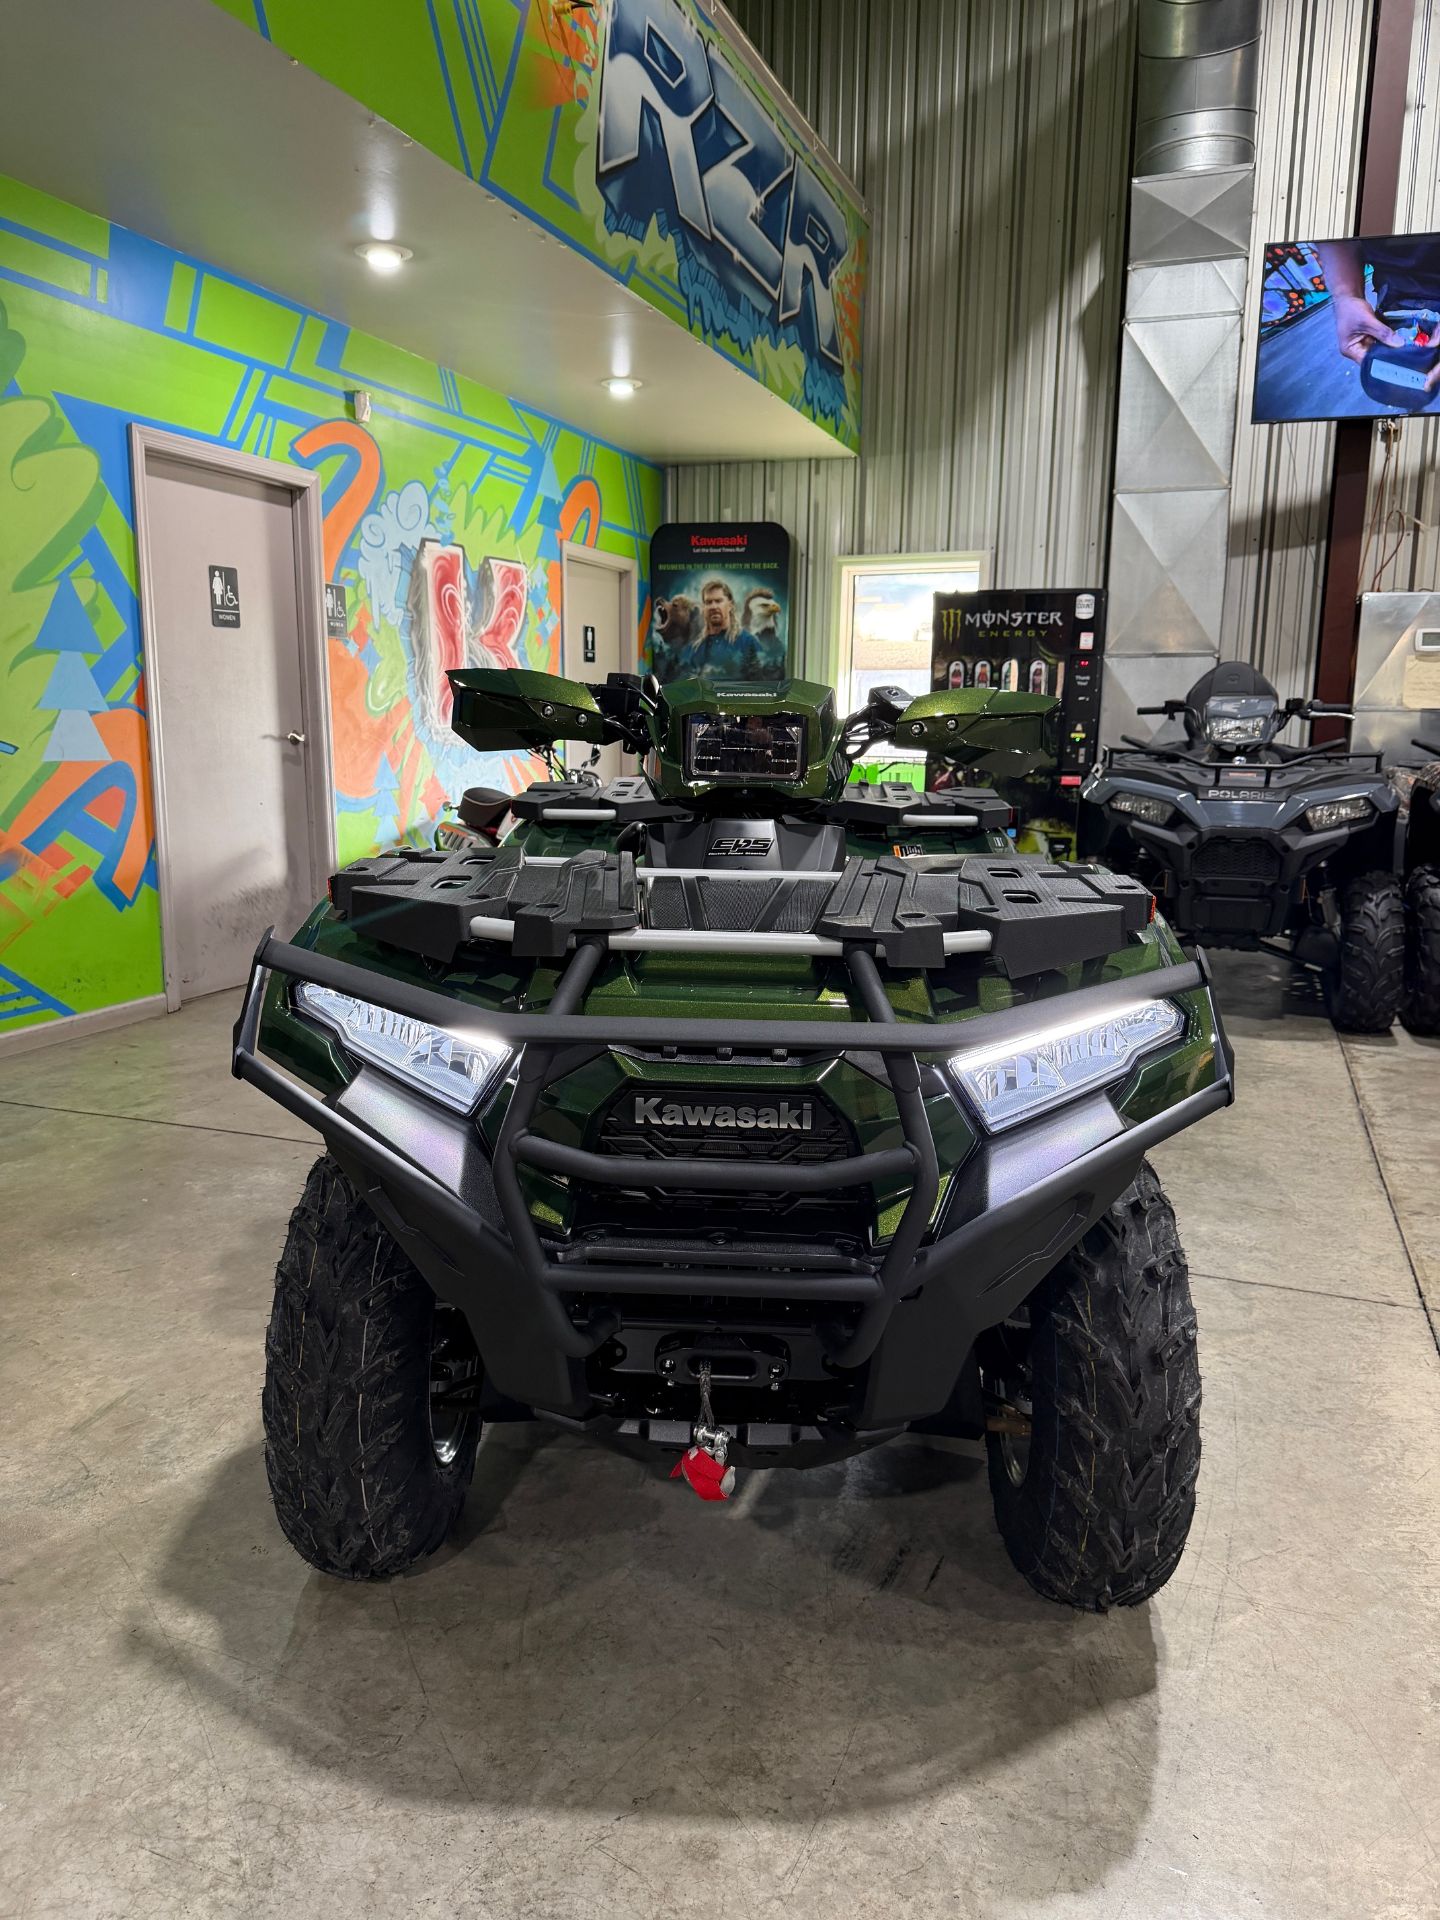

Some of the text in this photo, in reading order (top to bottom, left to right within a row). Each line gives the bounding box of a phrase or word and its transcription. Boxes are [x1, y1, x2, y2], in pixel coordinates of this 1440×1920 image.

[598, 0, 847, 372] RZR
[691, 535, 748, 546] Kawasaki
[965, 609, 1063, 628] MONSTER
[1208, 789, 1275, 799] POLARIS
[711, 838, 773, 852] EPS
[634, 1097, 812, 1130] Kawasaki
